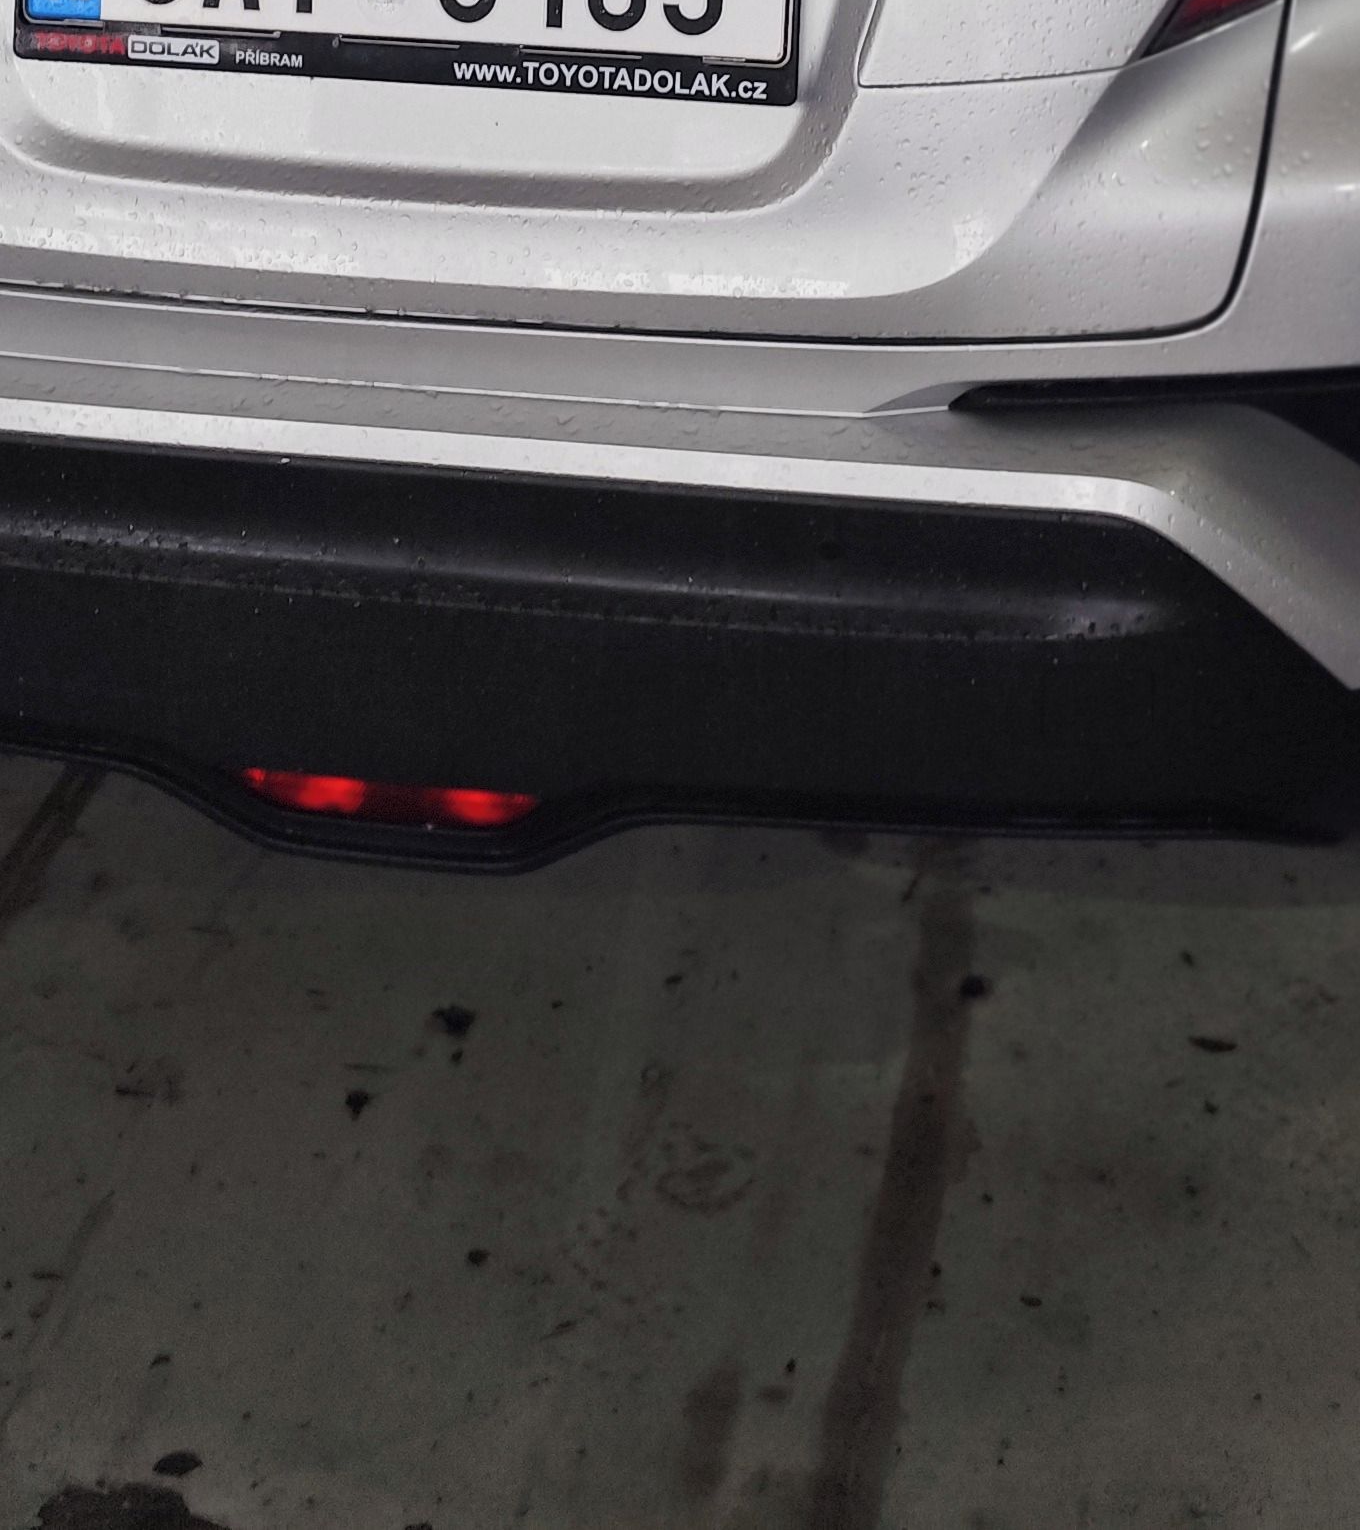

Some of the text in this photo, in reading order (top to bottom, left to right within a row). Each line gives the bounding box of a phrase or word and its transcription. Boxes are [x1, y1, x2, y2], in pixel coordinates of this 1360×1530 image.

[34, 30, 126, 56] TOYOTA
[235, 48, 304, 69] PŘÍBRAM
[453, 60, 768, 100] www.TOYOTADOLAK.cz
